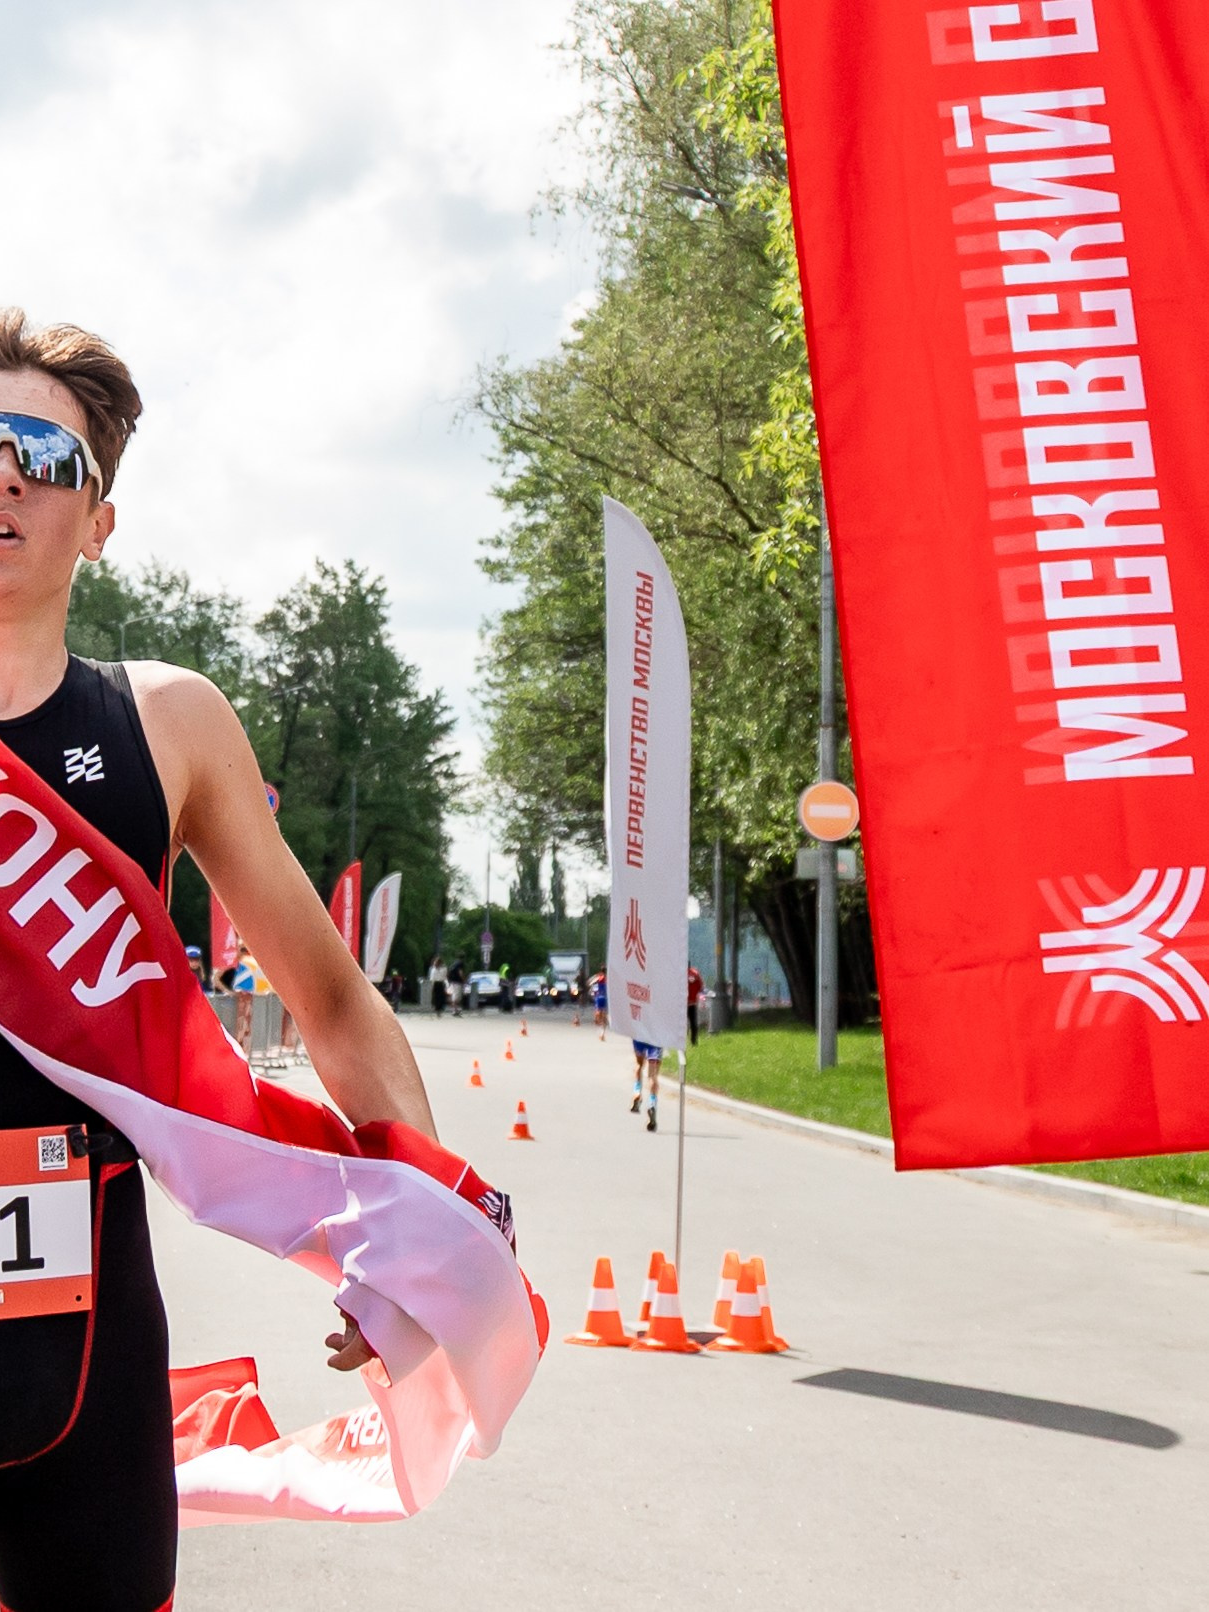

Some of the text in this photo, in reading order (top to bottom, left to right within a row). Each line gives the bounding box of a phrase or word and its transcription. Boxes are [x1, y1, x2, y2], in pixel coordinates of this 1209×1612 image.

[951, 86, 1195, 781] МОСКОВСКИЙ
[626, 570, 654, 870] ПЕРВЕНСТВО МОСКВЫ
